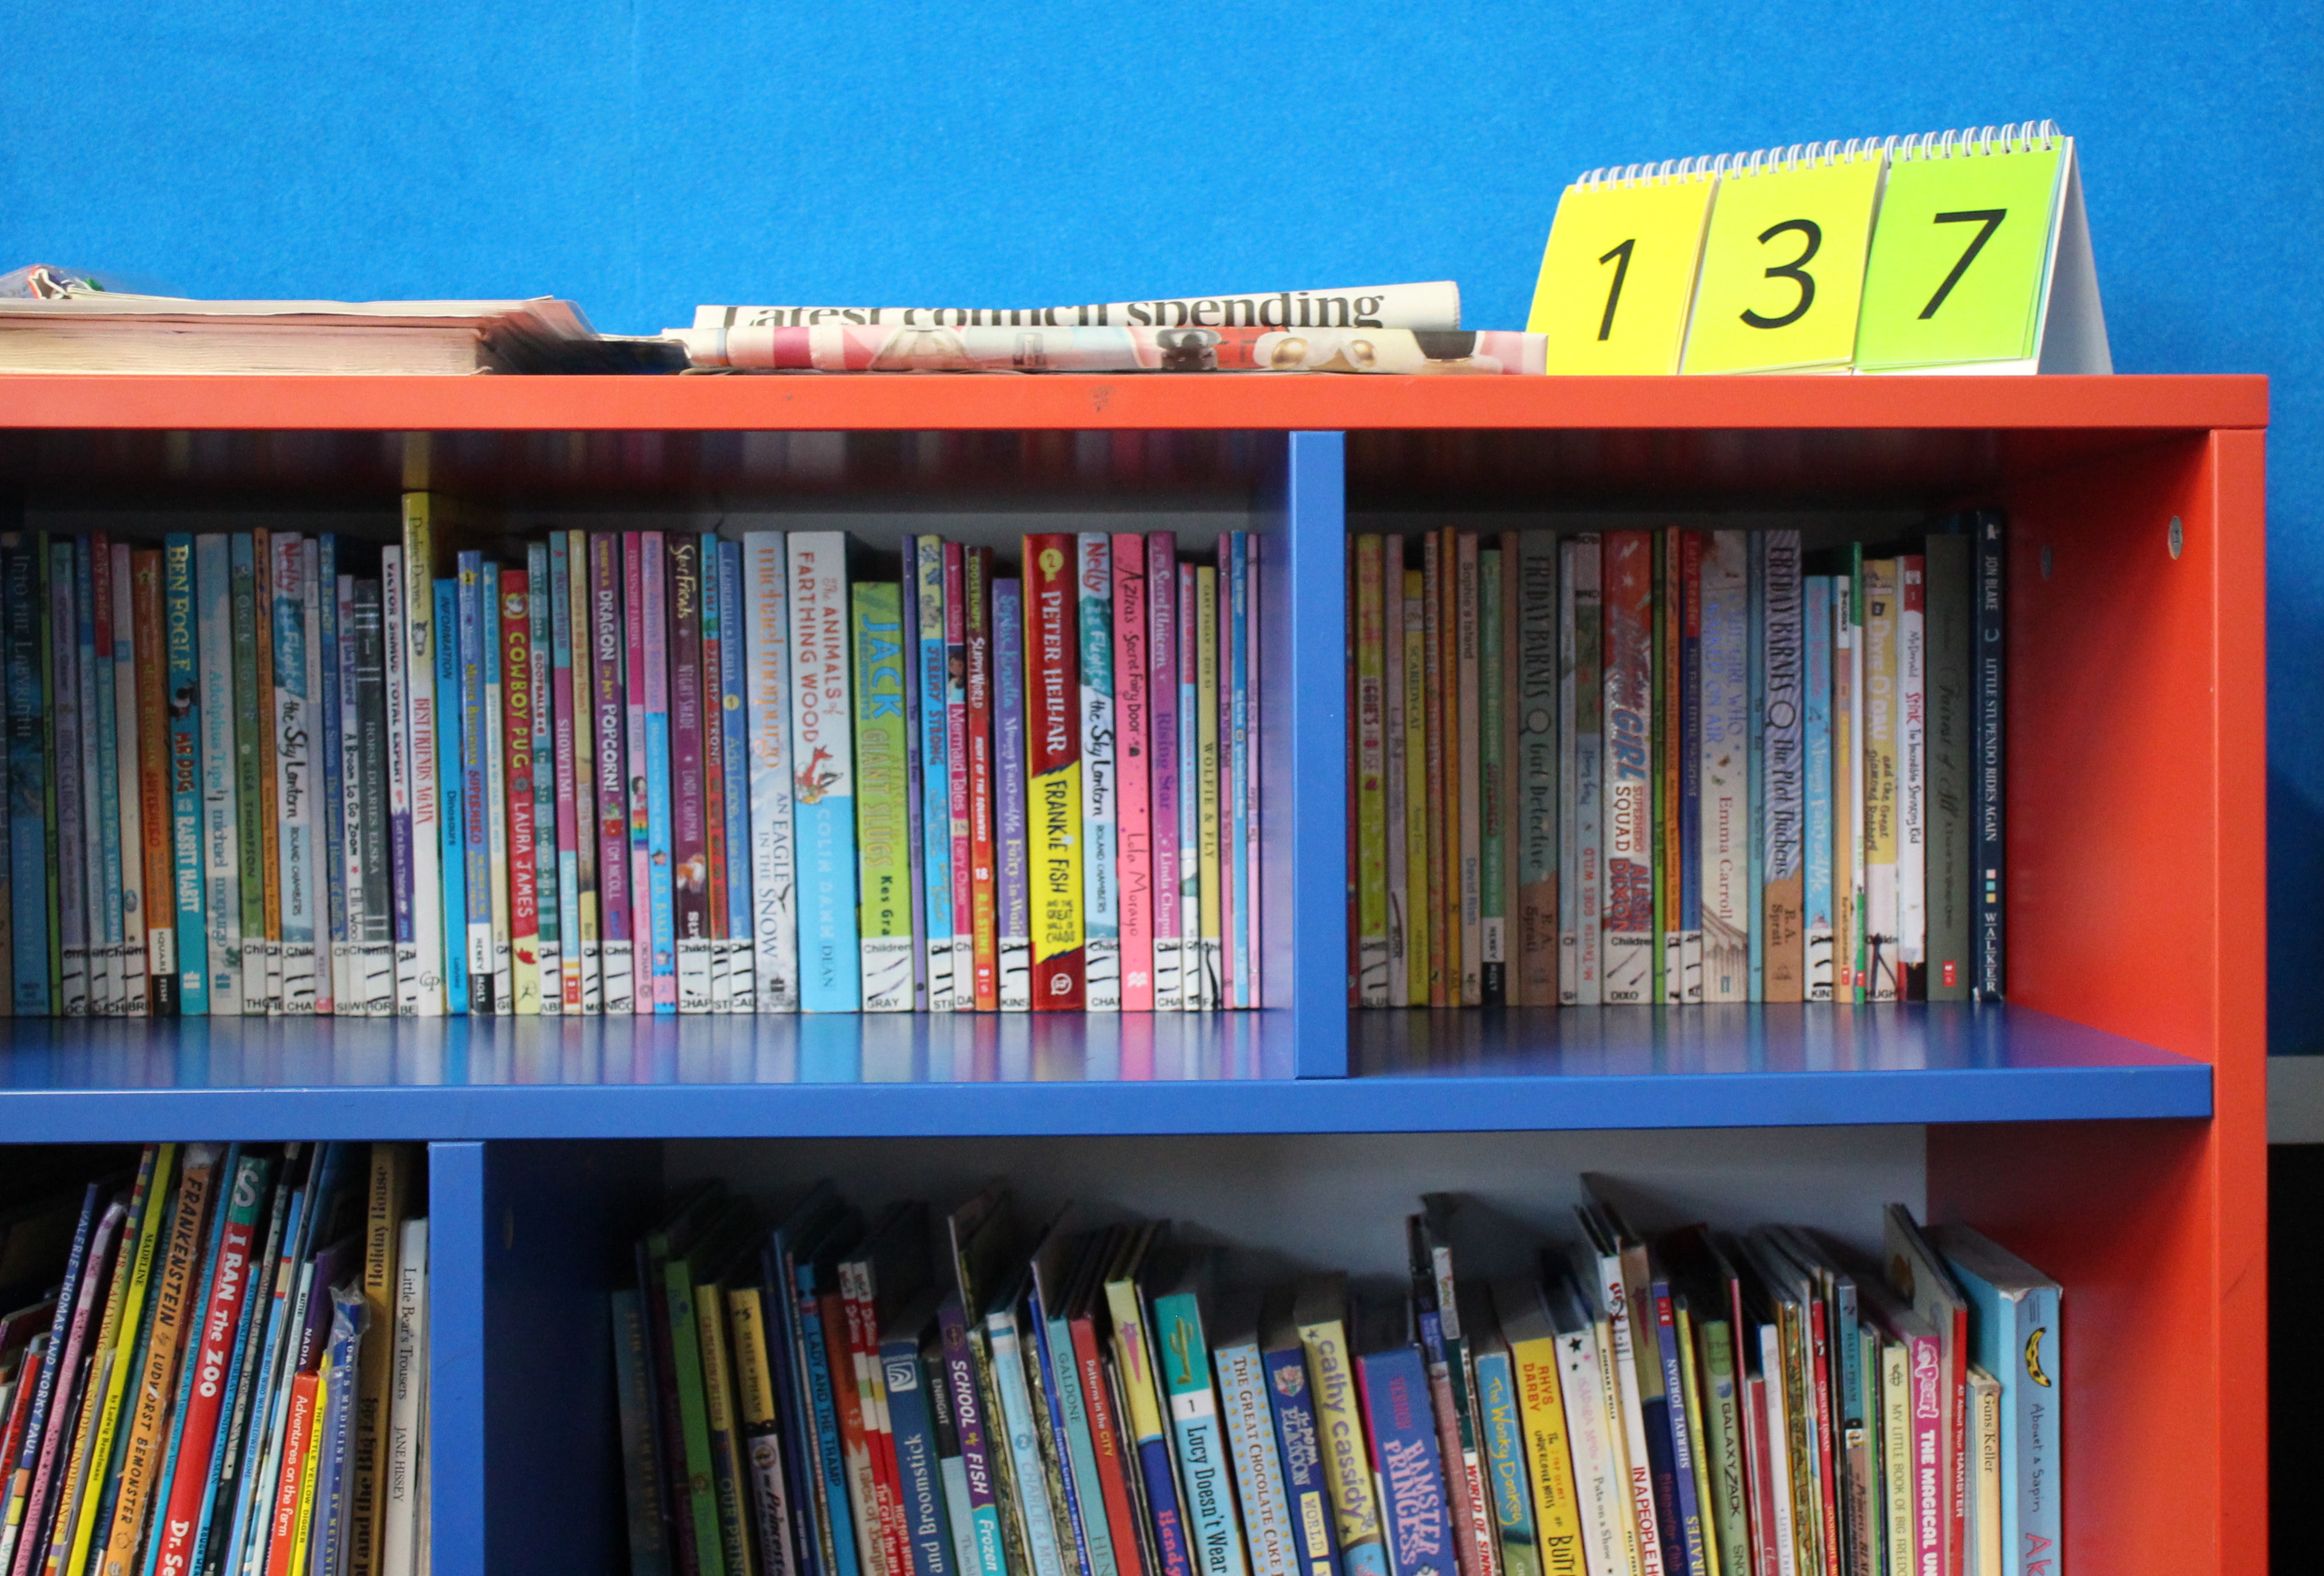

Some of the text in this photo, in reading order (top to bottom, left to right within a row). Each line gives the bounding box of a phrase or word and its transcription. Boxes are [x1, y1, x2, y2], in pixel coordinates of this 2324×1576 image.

[1126, 292, 1385, 328] spending
[1598, 208, 2007, 341] 1 3 7
[169, 545, 190, 671] BEN FOGLE
[440, 595, 452, 681] INFORMATION
[599, 590, 615, 661] DRAGON
[1461, 561, 1474, 617] Sophie's
[1524, 556, 1551, 700] FRIDAY BARNES
[1769, 547, 1795, 692] FRIDAY BARNES
[1984, 554, 1999, 612] JON BLAKE
[509, 631, 528, 768] COWBOY PUG
[754, 547, 785, 769] michael morpurgo
[797, 551, 820, 743] FARTHING WOOD
[862, 613, 901, 720] JACK
[1040, 591, 1067, 756] PETER HELLIAR
[1116, 567, 1143, 733] Aziza's Secret Fairy Door
[174, 733, 195, 793] MR DOG
[278, 702, 308, 820] the Sky Lantern
[414, 698, 433, 826] BEST FRIENDS AGAIN
[602, 703, 619, 793] POPCORN!
[862, 728, 896, 869] GIANT SLUGS
[1085, 701, 1113, 818] the Sky Lantern
[1985, 657, 1998, 842] LITTLE STUPENDO RIDES AGAIN
[244, 801, 256, 878] THOMPSON
[514, 801, 532, 917] LAURA JAMES
[772, 792, 792, 883] AN EAGLE
[1044, 780, 1069, 852] FRANKIE
[1613, 786, 1631, 852] SQUAD
[1718, 796, 1733, 919] Emma Carroll
[1771, 738, 1796, 877] The Plot Thickens
[178, 815, 200, 913] RABBIT HABIT
[759, 831, 779, 959] IN THE SNOW
[1047, 858, 1070, 894] FISH
[1609, 857, 1631, 933] DIXON
[822, 945, 833, 988] DEAN
[135, 1232, 154, 1287] MADELINE
[368, 1165, 389, 1287] Holiday House
[23, 1210, 90, 1457] VALERIE THOMAS AND KORKY PAUL
[199, 1235, 247, 1398] I RAN The ZOO
[299, 1327, 313, 1367] NADIA
[93, 1394, 119, 1482] by Ludwig Bemelmans
[393, 1267, 417, 1502] Little Bear's Trousers JANE HISSEY
[807, 1331, 842, 1487] LADY AND THE TRAMP
[932, 1378, 950, 1426] ENRIGHT
[1058, 1351, 1081, 1423] GALDONE
[1086, 1359, 1113, 1458] Patterns in the CITY
[1319, 1340, 1368, 1520] cathy cassidy
[1523, 1363, 1541, 1411] DARBY
[1538, 1365, 1554, 1406] RHYS
[1607, 1394, 1616, 1421] WELLS
[1666, 1358, 1690, 1469] SHERRYL JORDAN
[277, 1395, 308, 1537] Adventures on the farm
[299, 1406, 323, 1545] THE LITTLE YELLOW DIGGER
[904, 1433, 944, 1574] and Broomstick
[1186, 1425, 1230, 1574] Lucy Doesn't Wear
[1232, 1356, 1284, 1568] THE GREAT CHOCOLATE CAKE
[1383, 1440, 1421, 1565] PRINCESS
[1403, 1439, 1441, 1555] HAMSTER
[1466, 1464, 1486, 1534] WORLD OF
[1488, 1377, 1524, 1527] The Wonky Donkey
[1593, 1476, 1605, 1502] Puts
[1892, 1403, 1906, 1535] MY LITTLE BOOK OF BIG
[1920, 1429, 1937, 1549] THE MAGICAL
[1956, 1452, 1964, 1518] HAMSTER
[168, 1518, 190, 1549] Dr.
[977, 1519, 998, 1572] Frozen
[1305, 1498, 1324, 1552] WORLD
[1598, 1504, 1606, 1521] on
[1601, 1529, 1613, 1560] Show
[1632, 1466, 1657, 1561] IN A PEOPLE
